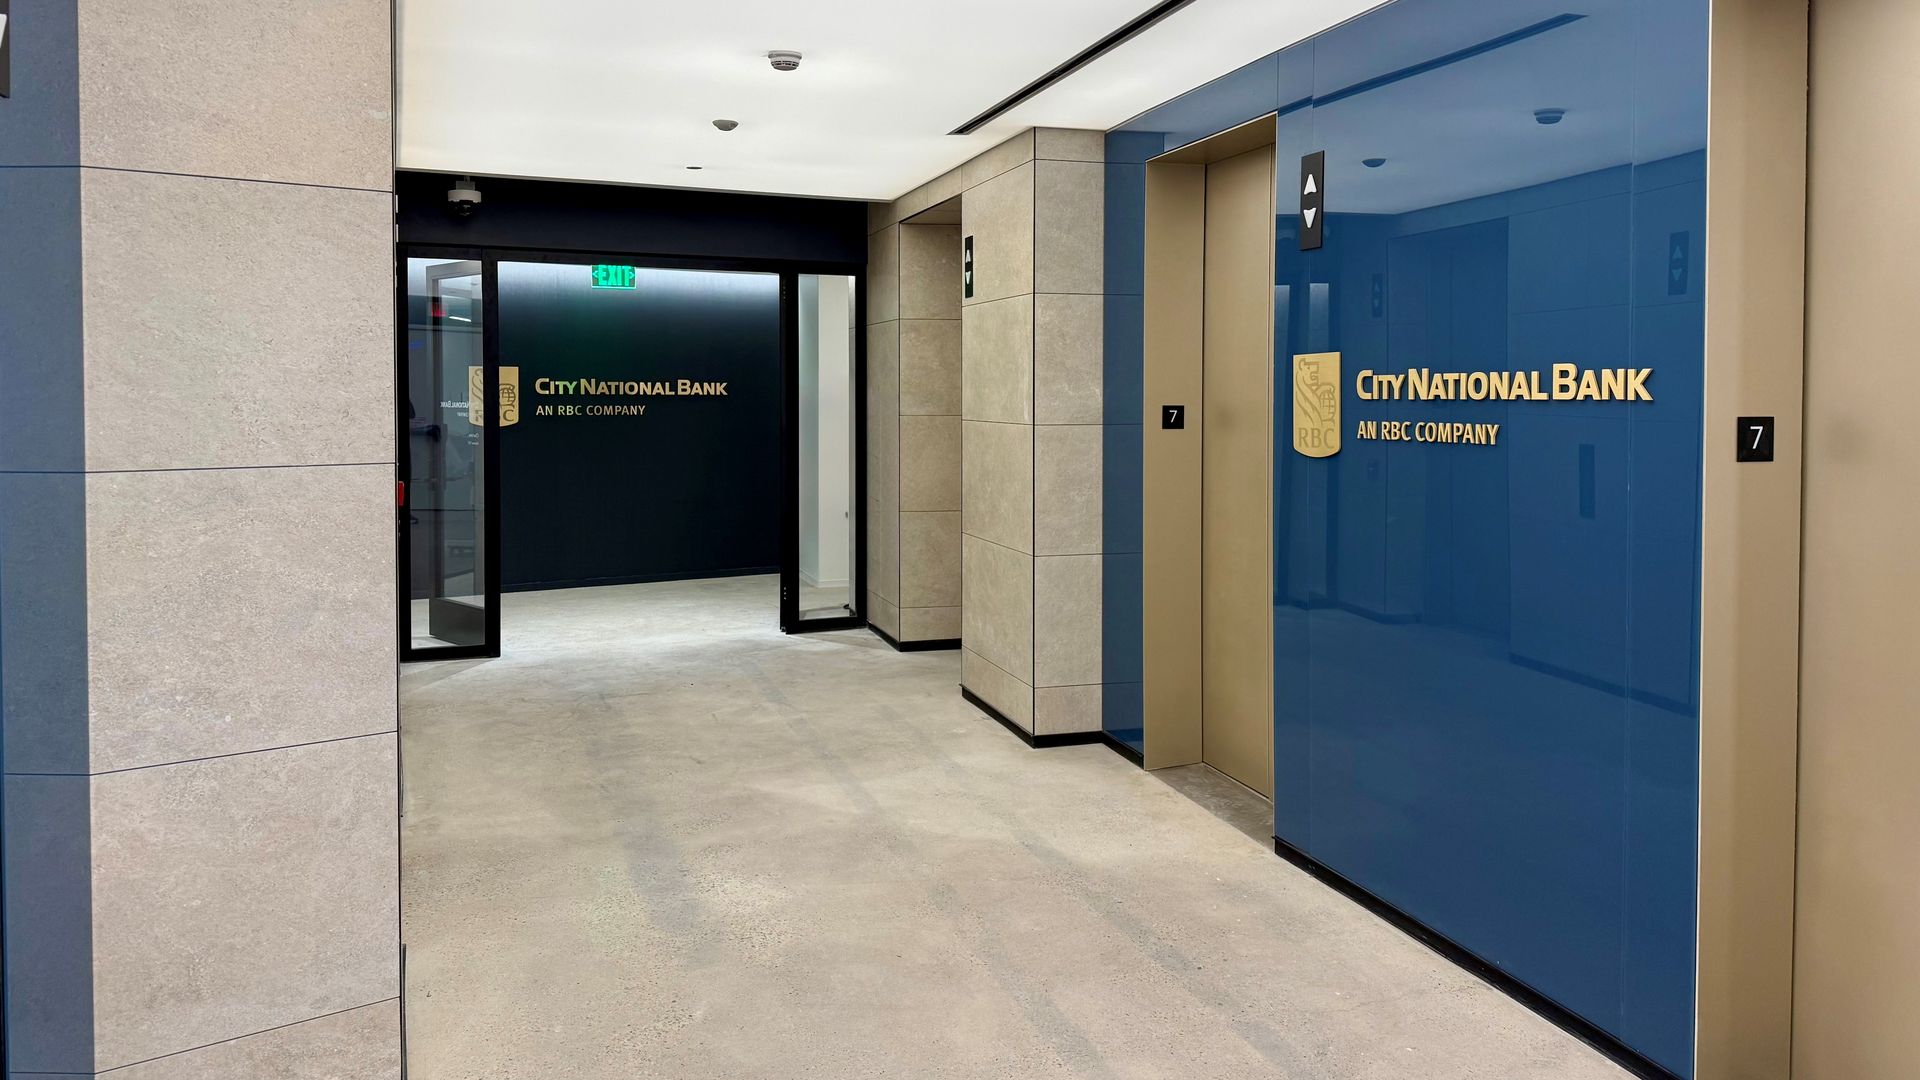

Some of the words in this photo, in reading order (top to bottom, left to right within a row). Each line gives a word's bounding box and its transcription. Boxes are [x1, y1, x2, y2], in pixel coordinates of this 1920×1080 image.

[598, 265, 631, 287] EXIT
[536, 405, 553, 416] AN
[557, 405, 582, 416] RBC
[586, 405, 646, 416] COMPANY
[1169, 409, 1178, 423] 7
[1298, 427, 1335, 449] RBC
[1356, 420, 1377, 440] AN
[1381, 421, 1411, 442] RBC
[1415, 422, 1499, 445] COMPANY
[1750, 425, 1764, 450] 7
